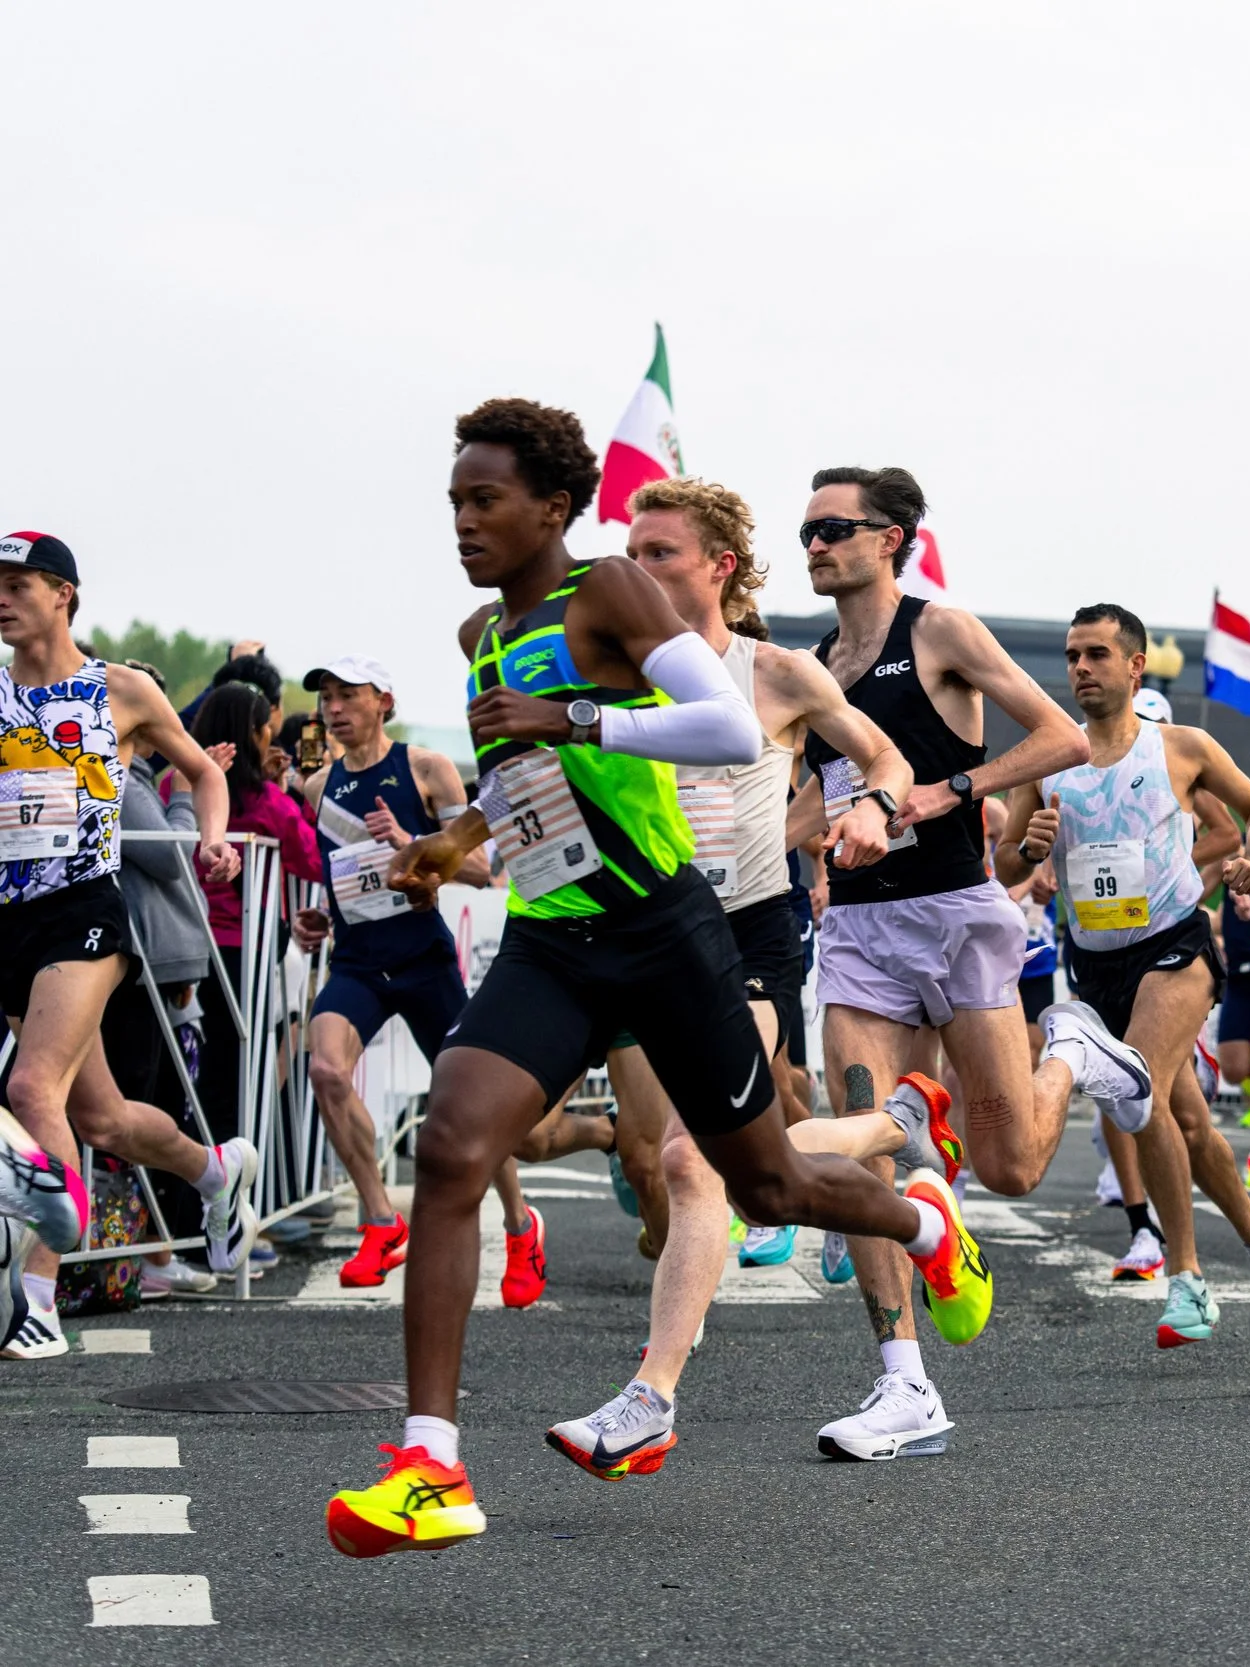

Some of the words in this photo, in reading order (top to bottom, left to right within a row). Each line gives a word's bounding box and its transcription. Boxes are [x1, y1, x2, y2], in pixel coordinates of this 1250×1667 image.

[874, 659, 911, 677] GRC
[334, 780, 358, 800] ZAP
[20, 803, 45, 825] 67
[513, 809, 544, 847] 33
[357, 871, 381, 893] 29
[1098, 867, 1111, 875] Phil
[1094, 876, 1118, 898] 99
